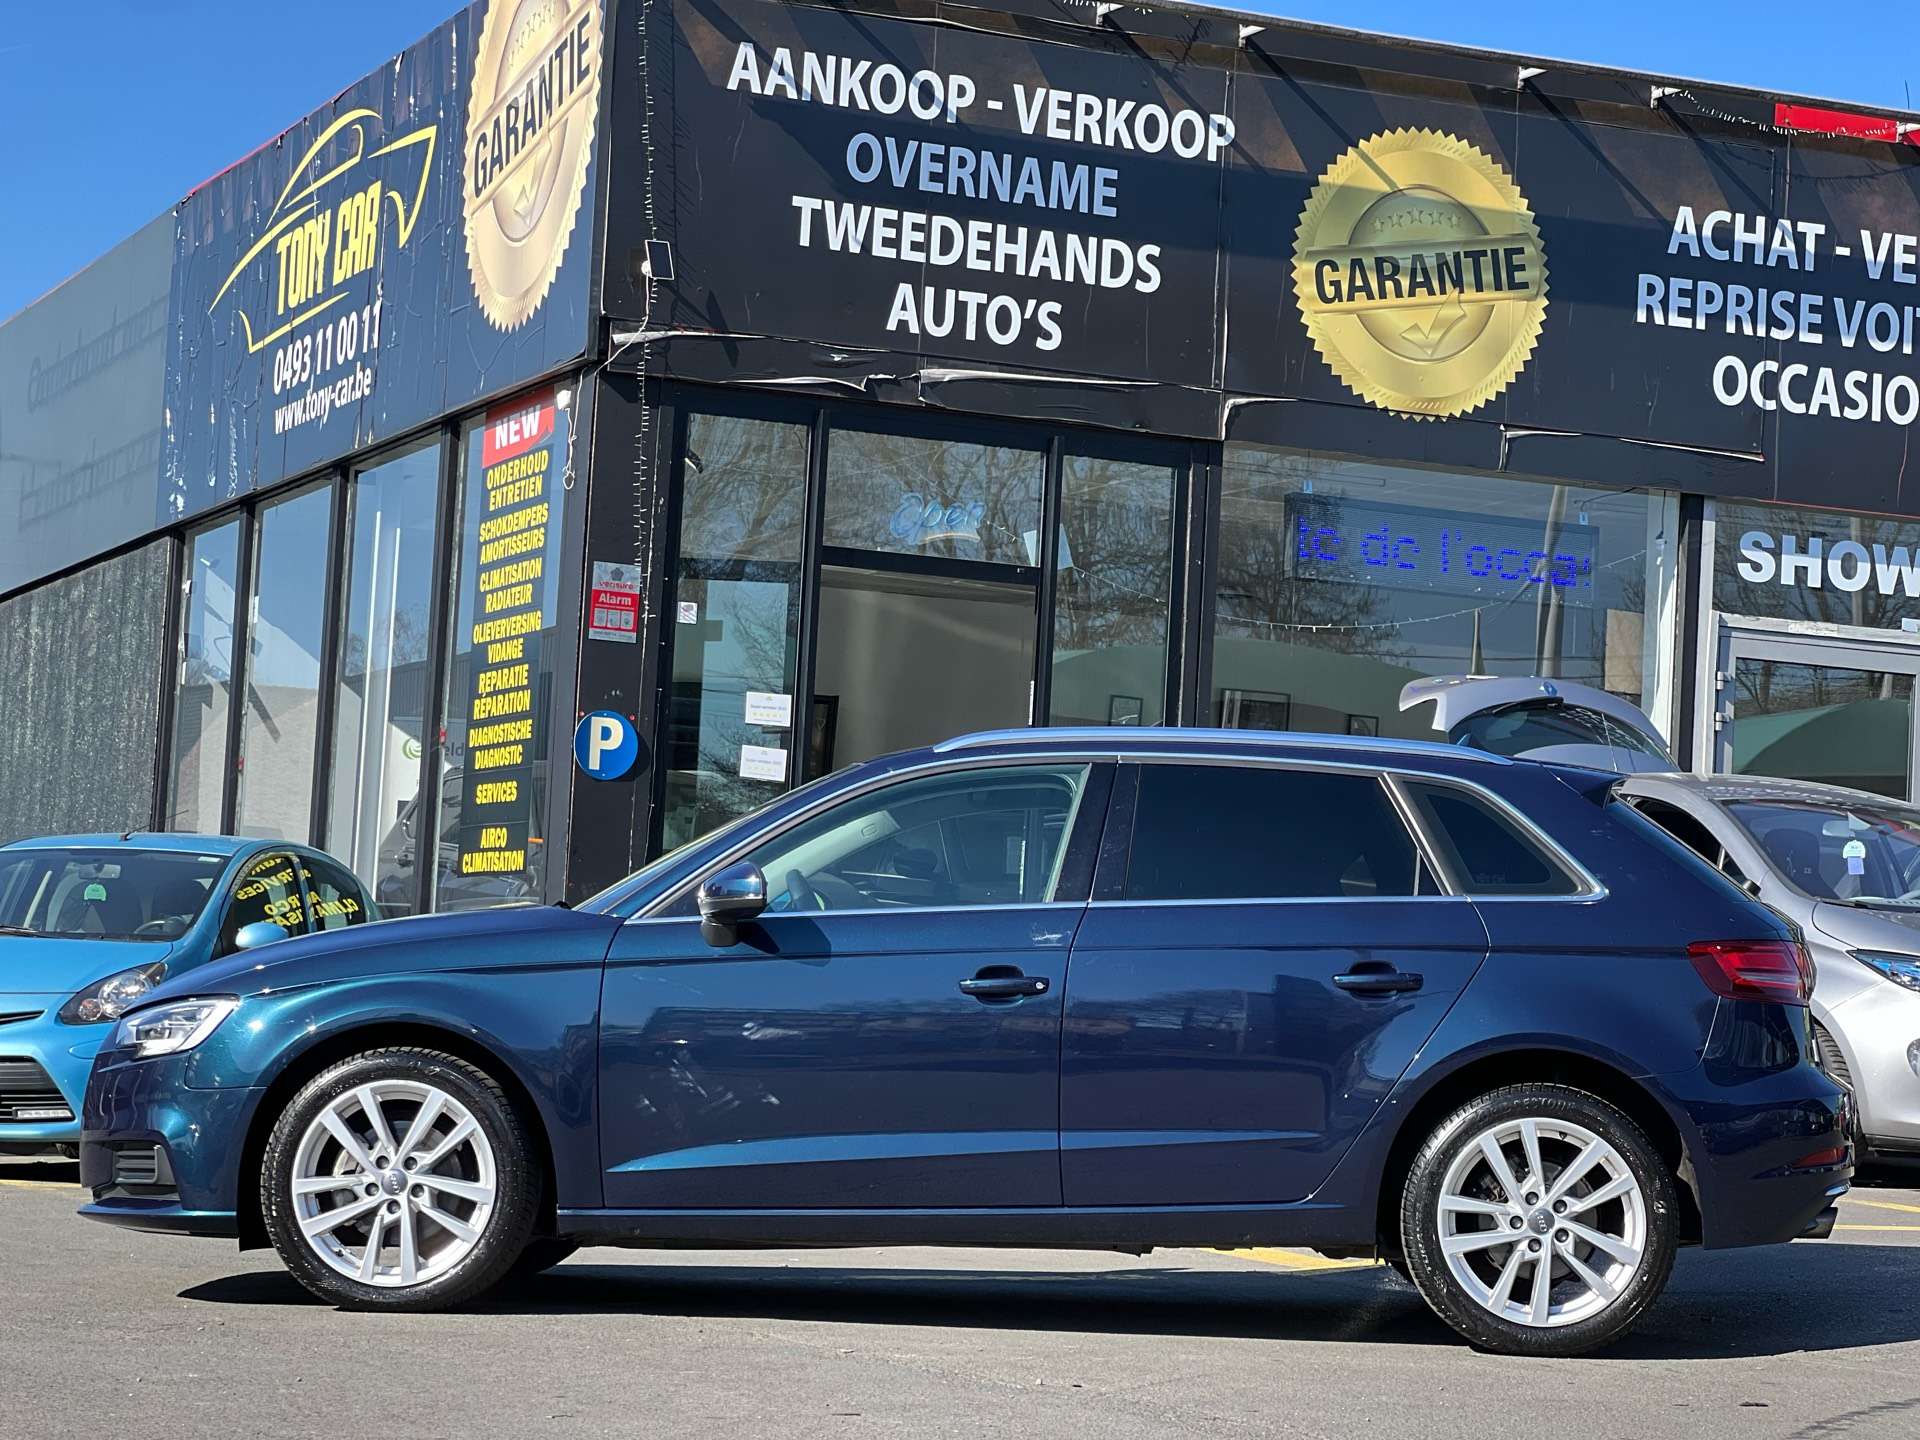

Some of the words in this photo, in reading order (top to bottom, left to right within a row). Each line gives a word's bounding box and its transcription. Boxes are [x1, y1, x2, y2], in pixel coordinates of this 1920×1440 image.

[474, 11, 590, 199] GARANTIE
[727, 42, 975, 124] AANKOOP
[1013, 83, 1236, 162] VERKOOP
[846, 132, 1119, 217] OVERNAME
[276, 209, 331, 316] TONY
[333, 180, 382, 287] CAR
[791, 196, 1161, 293] TWEEDEHANDS
[1666, 205, 1825, 272] ACHAT
[1860, 229, 1918, 284] VE
[1315, 247, 1530, 304] GARANTIE
[886, 283, 1063, 351] AUTO'S
[1636, 273, 1823, 344] REPRISE
[1833, 297, 1920, 355] VOI
[273, 334, 312, 395] 0493
[315, 323, 334, 376] 11
[336, 311, 358, 366] 00
[362, 299, 382, 353] 11
[274, 361, 372, 434] www.tony-car.be
[1712, 355, 1919, 425] OCCASIO
[495, 404, 541, 450] NEW
[487, 449, 549, 490] ONDERHOUD
[489, 474, 543, 512] ENTRETIEN
[480, 502, 549, 542] SCHOKDEMPERS
[480, 527, 545, 565] AMORTISSEURS
[1360, 522, 1420, 569] de
[1736, 530, 1920, 598] SHOW
[480, 557, 542, 592] CLIMATISATION
[485, 583, 533, 613] RADIATEUR
[599, 592, 632, 606] Alarm
[473, 611, 542, 644] OLIEVERVERSING
[488, 638, 523, 664] VIDANGE
[478, 663, 529, 694] REPARATIE
[473, 689, 531, 720] RÉPARATION
[469, 719, 533, 748] DIAGNOSTISCHE
[589, 716, 624, 771] P
[474, 744, 523, 770] DIAGNOSTIC
[476, 781, 517, 805] SERVICES
[480, 827, 507, 849] AIRCO
[462, 850, 524, 874] CLIMATISATION
